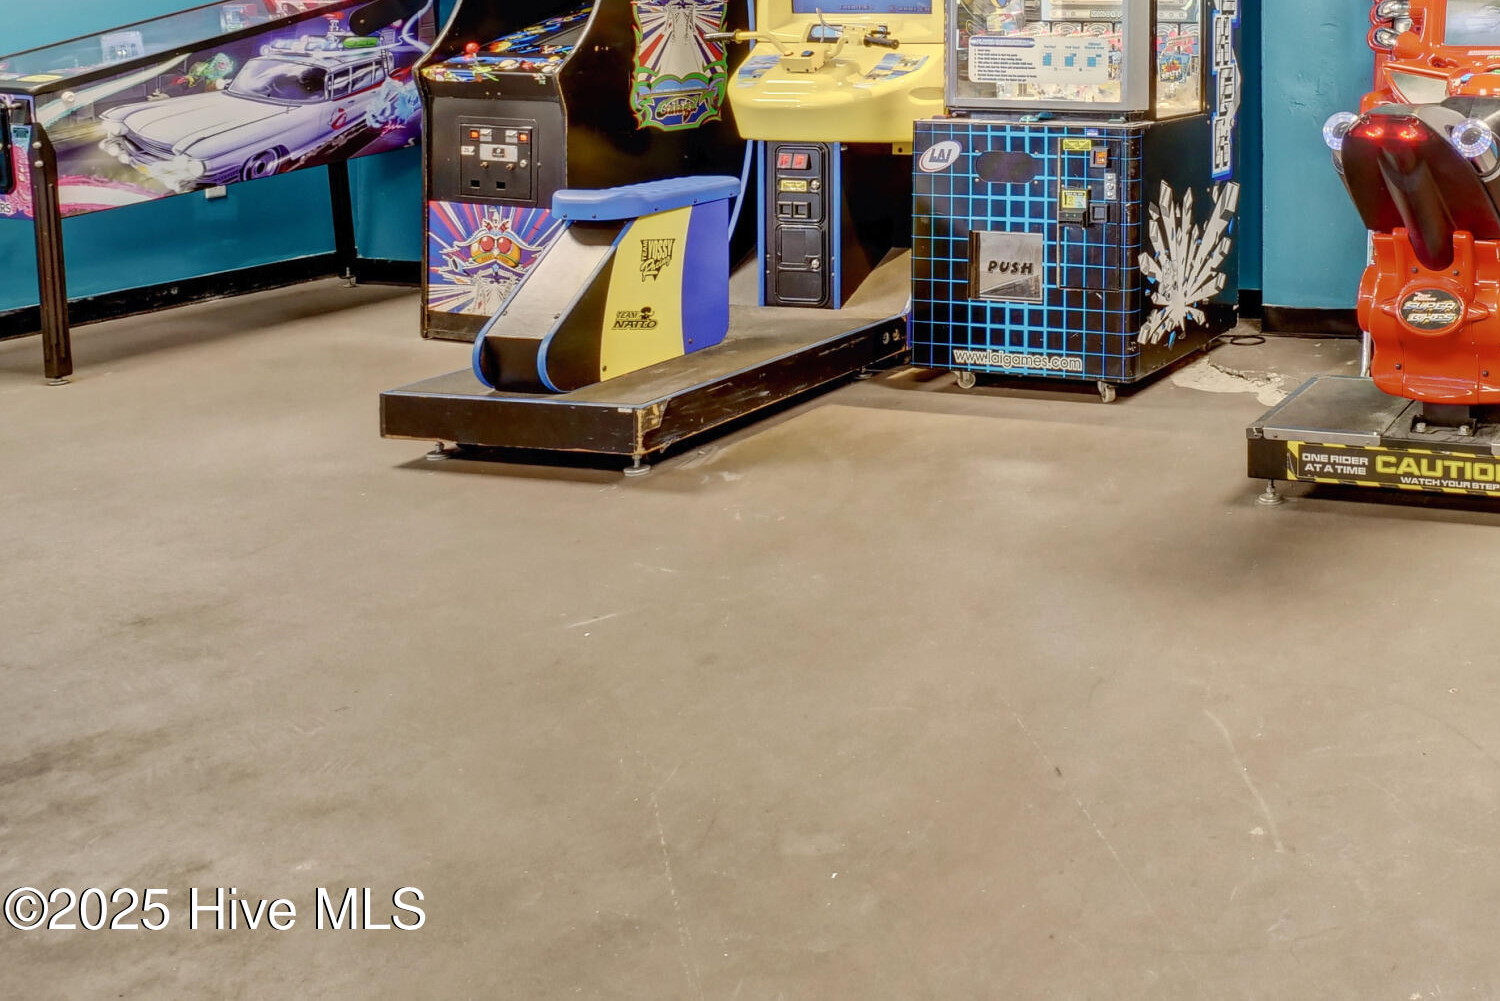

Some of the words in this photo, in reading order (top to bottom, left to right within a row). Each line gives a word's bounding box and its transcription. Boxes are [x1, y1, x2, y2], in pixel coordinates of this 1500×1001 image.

[988, 260, 1034, 275] PUSH
[1403, 300, 1456, 311] SUPER
[953, 348, 1084, 372] www.laigames.com
[1302, 453, 1329, 463] ONE
[1330, 455, 1369, 466] RIDER
[1305, 463, 1321, 472] AT
[1323, 465, 1334, 473] A
[1334, 465, 1367, 476] TIME
[1400, 476, 1440, 486] WATCH
[1440, 479, 1472, 488] YOUR
[1471, 481, 1500, 491] STEP
